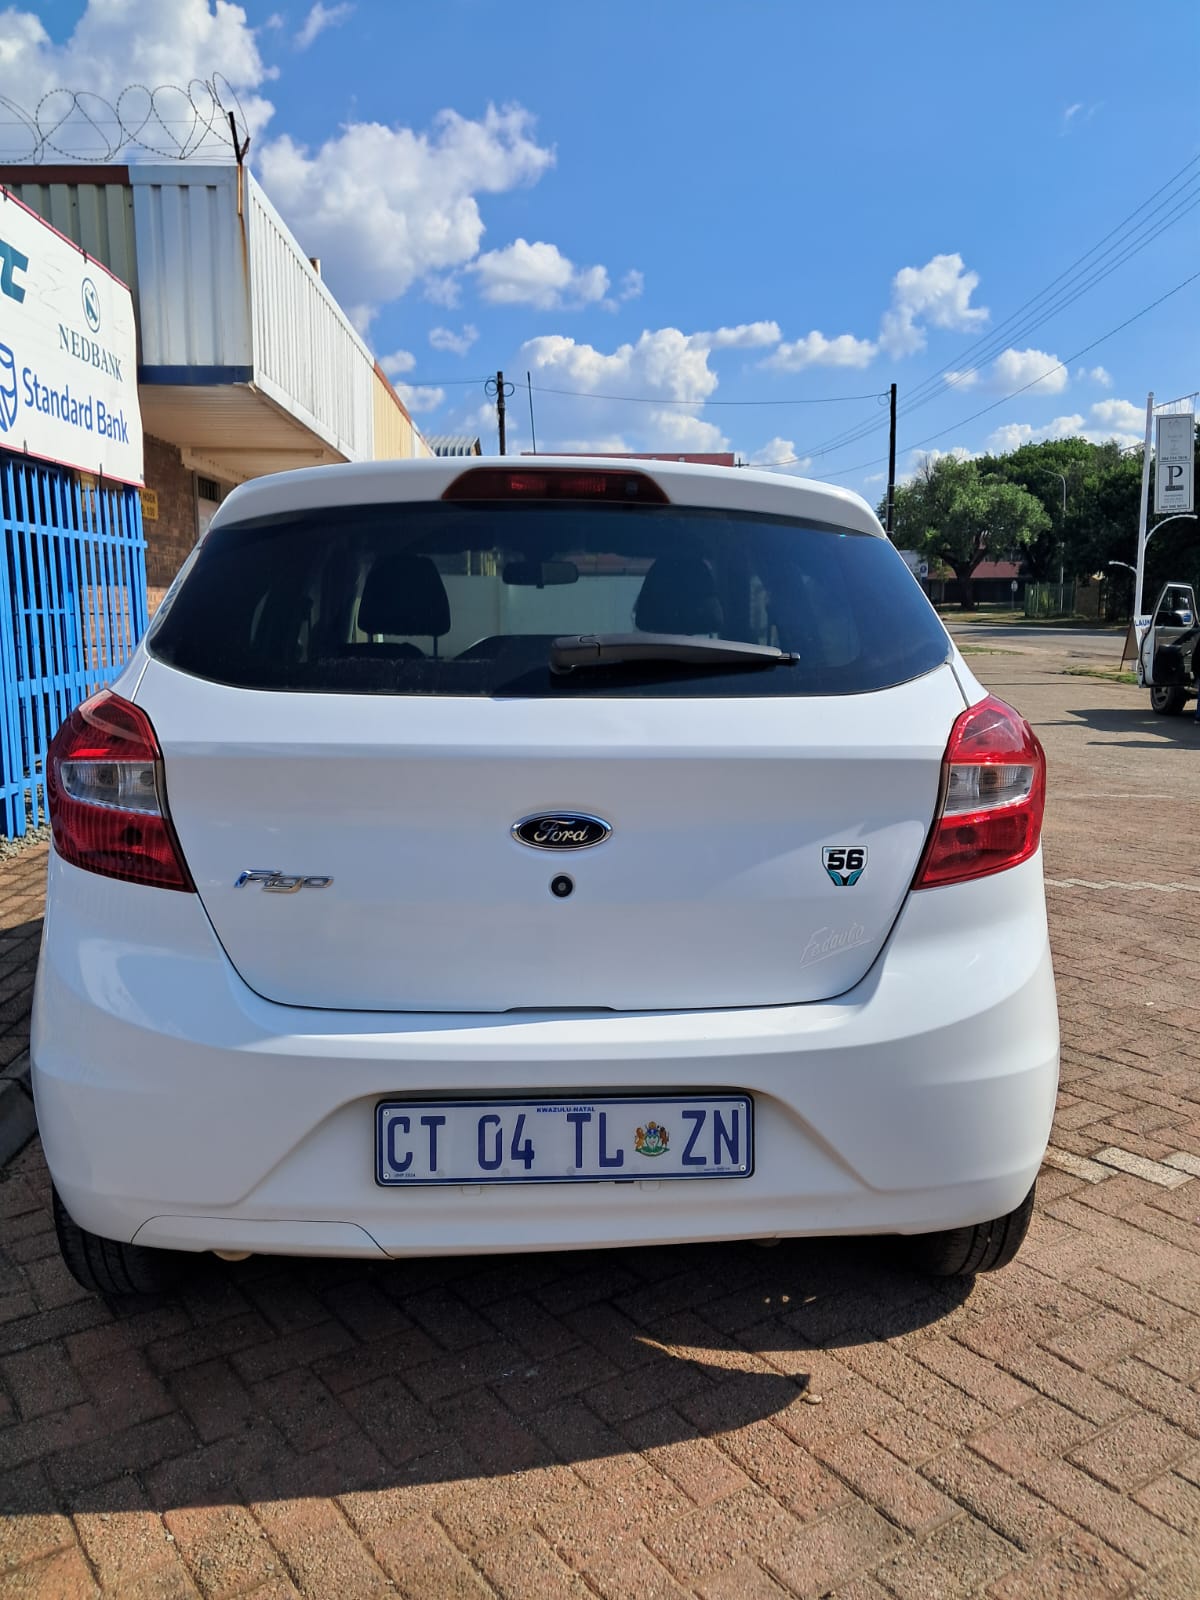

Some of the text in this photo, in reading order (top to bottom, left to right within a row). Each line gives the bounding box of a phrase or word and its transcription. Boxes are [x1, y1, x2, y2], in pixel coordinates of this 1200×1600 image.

[58, 323, 123, 382] NEDBANK
[22, 367, 129, 444] Standard Bank
[533, 819, 590, 842] Ford
[827, 848, 865, 871] 56
[234, 869, 334, 895] Figo
[387, 1109, 739, 1173] CT 04 TL ZN
